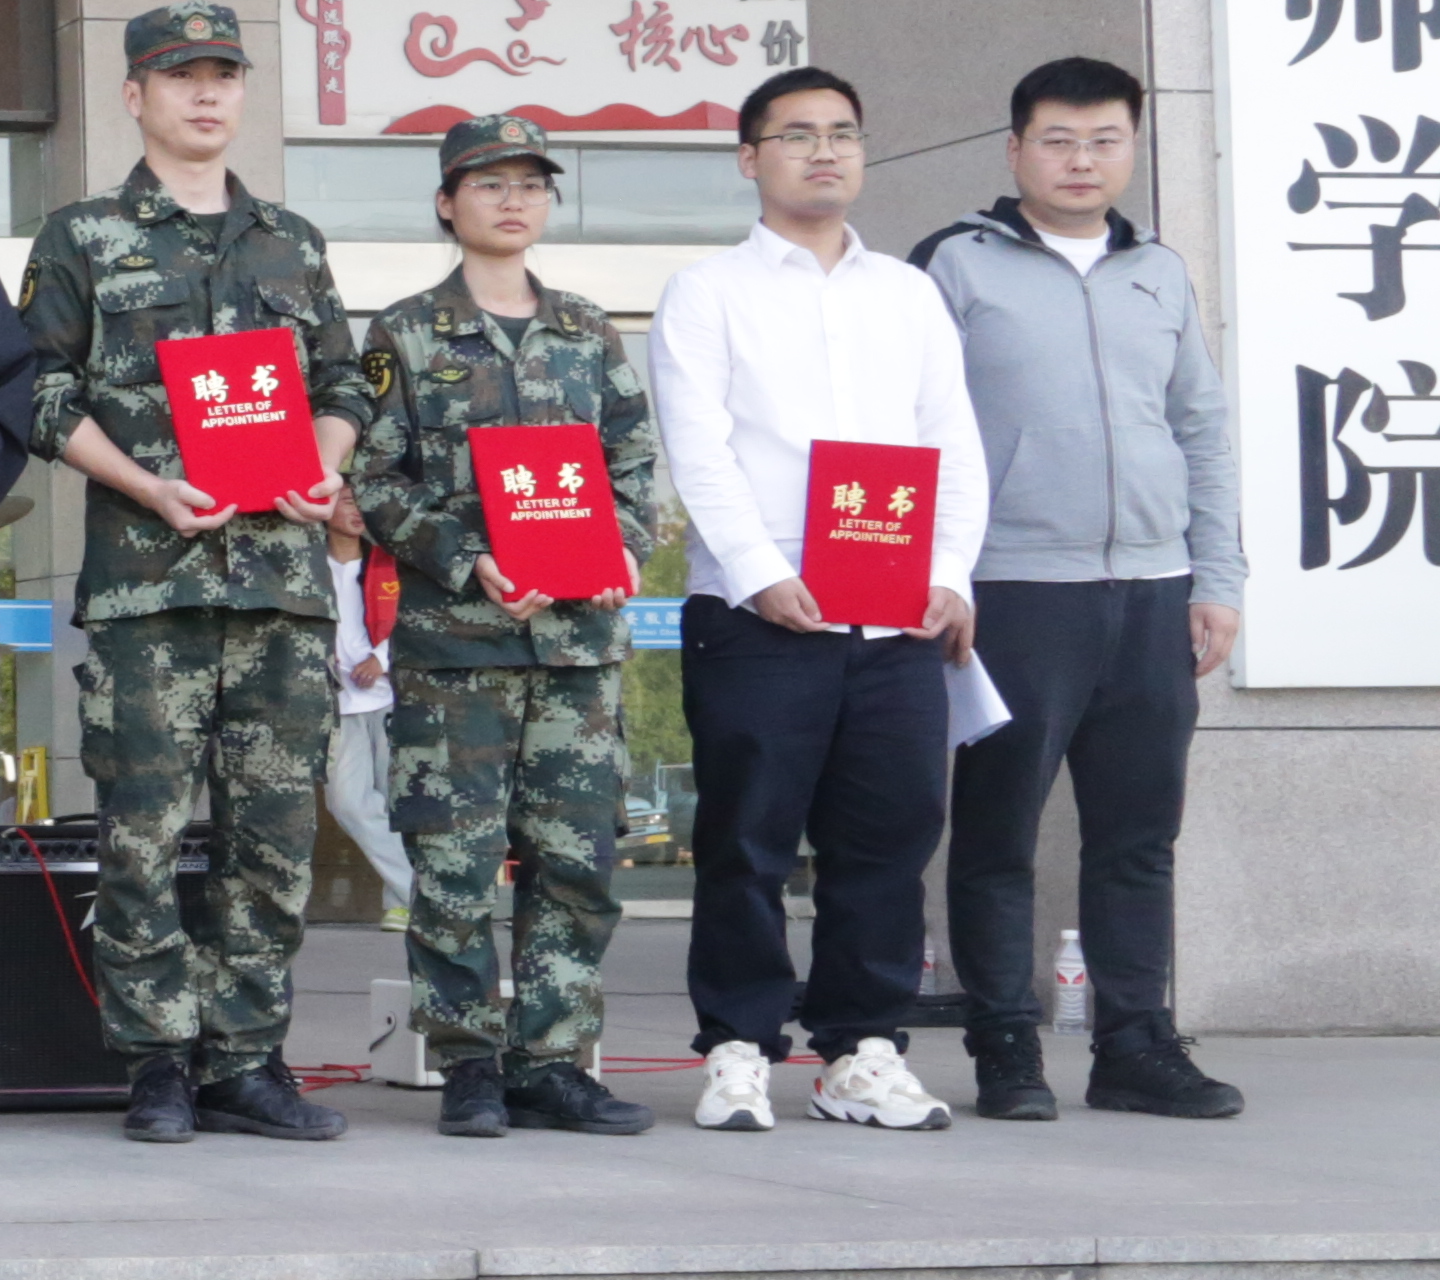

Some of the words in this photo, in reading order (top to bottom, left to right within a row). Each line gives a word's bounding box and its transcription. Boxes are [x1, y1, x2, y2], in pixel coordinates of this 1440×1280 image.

[191, 365, 279, 403] 聘书
[208, 403, 254, 416] LETTER
[255, 400, 271, 411] OF
[202, 410, 286, 428] APPOINTMENT
[500, 463, 584, 497] 聘书
[516, 498, 560, 509] LETTER
[562, 498, 577, 507] OF
[832, 482, 916, 518] 聘书
[511, 508, 591, 520] APPOINTMENT
[840, 519, 883, 530] LETTER
[886, 522, 901, 531] OF
[830, 530, 911, 544] APPOINTMENT
